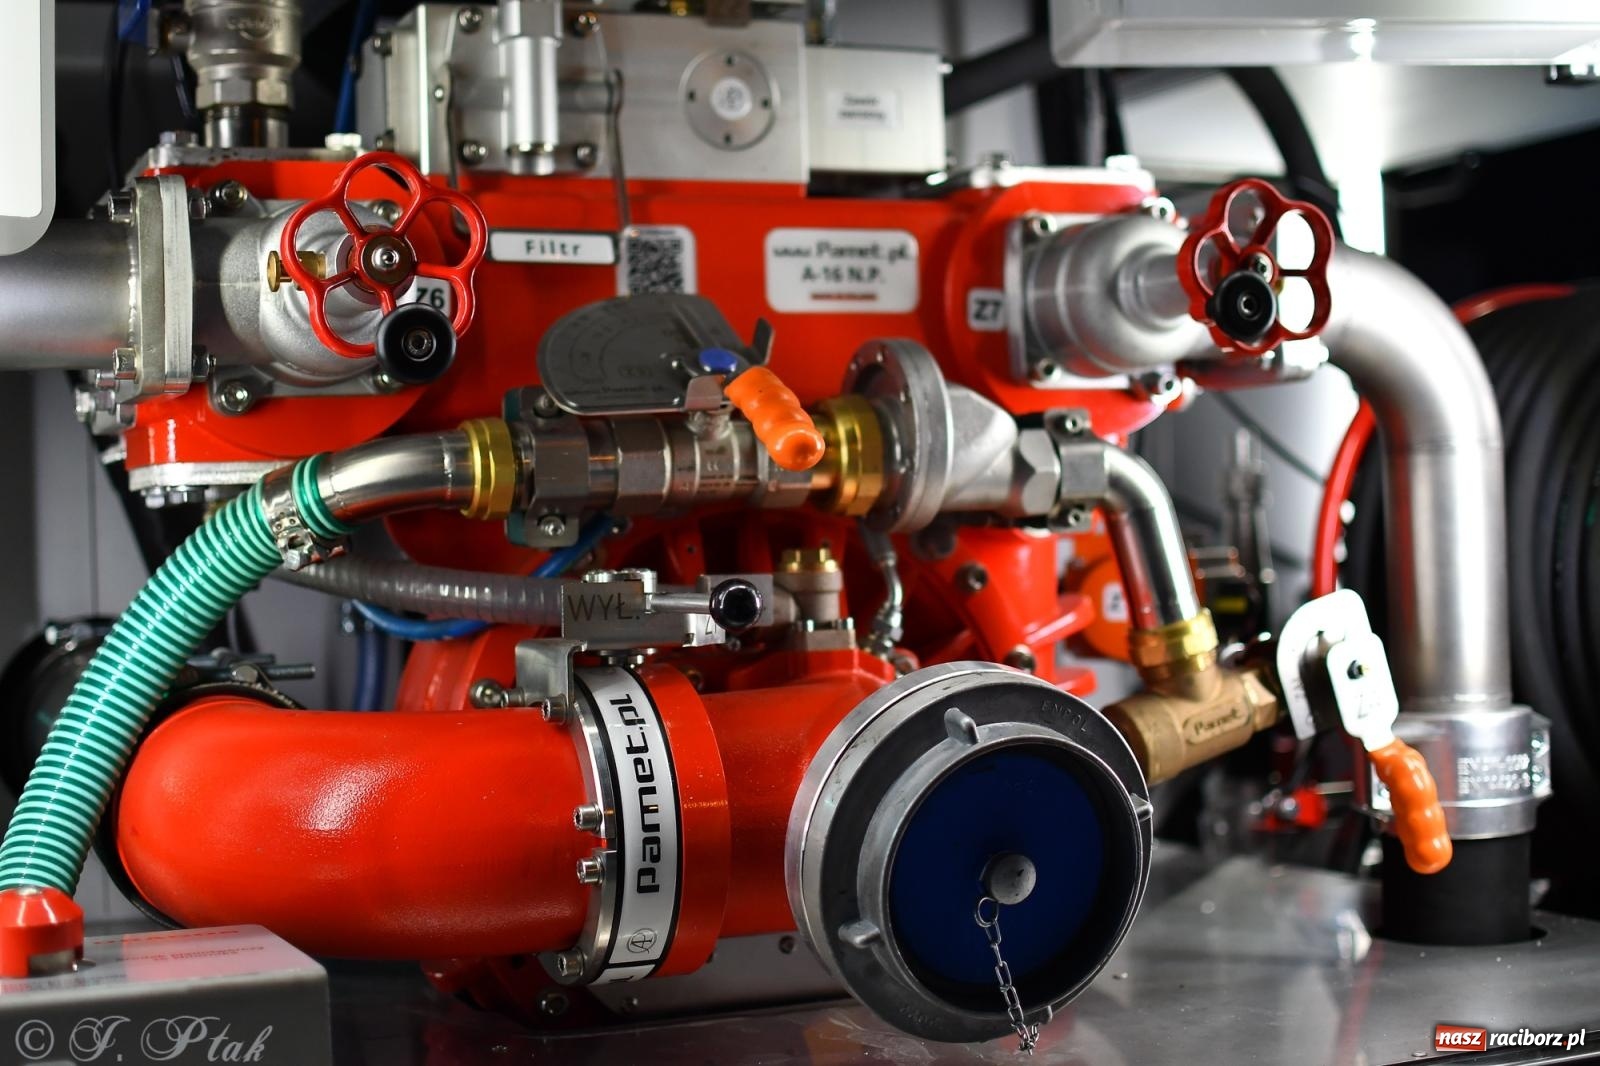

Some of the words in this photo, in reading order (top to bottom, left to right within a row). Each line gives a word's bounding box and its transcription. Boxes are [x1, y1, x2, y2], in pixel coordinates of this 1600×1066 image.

[525, 239, 582, 256] Filtr
[416, 287, 445, 310] Z6
[974, 299, 1003, 321] Z7
[567, 592, 641, 621] WYŁ.
